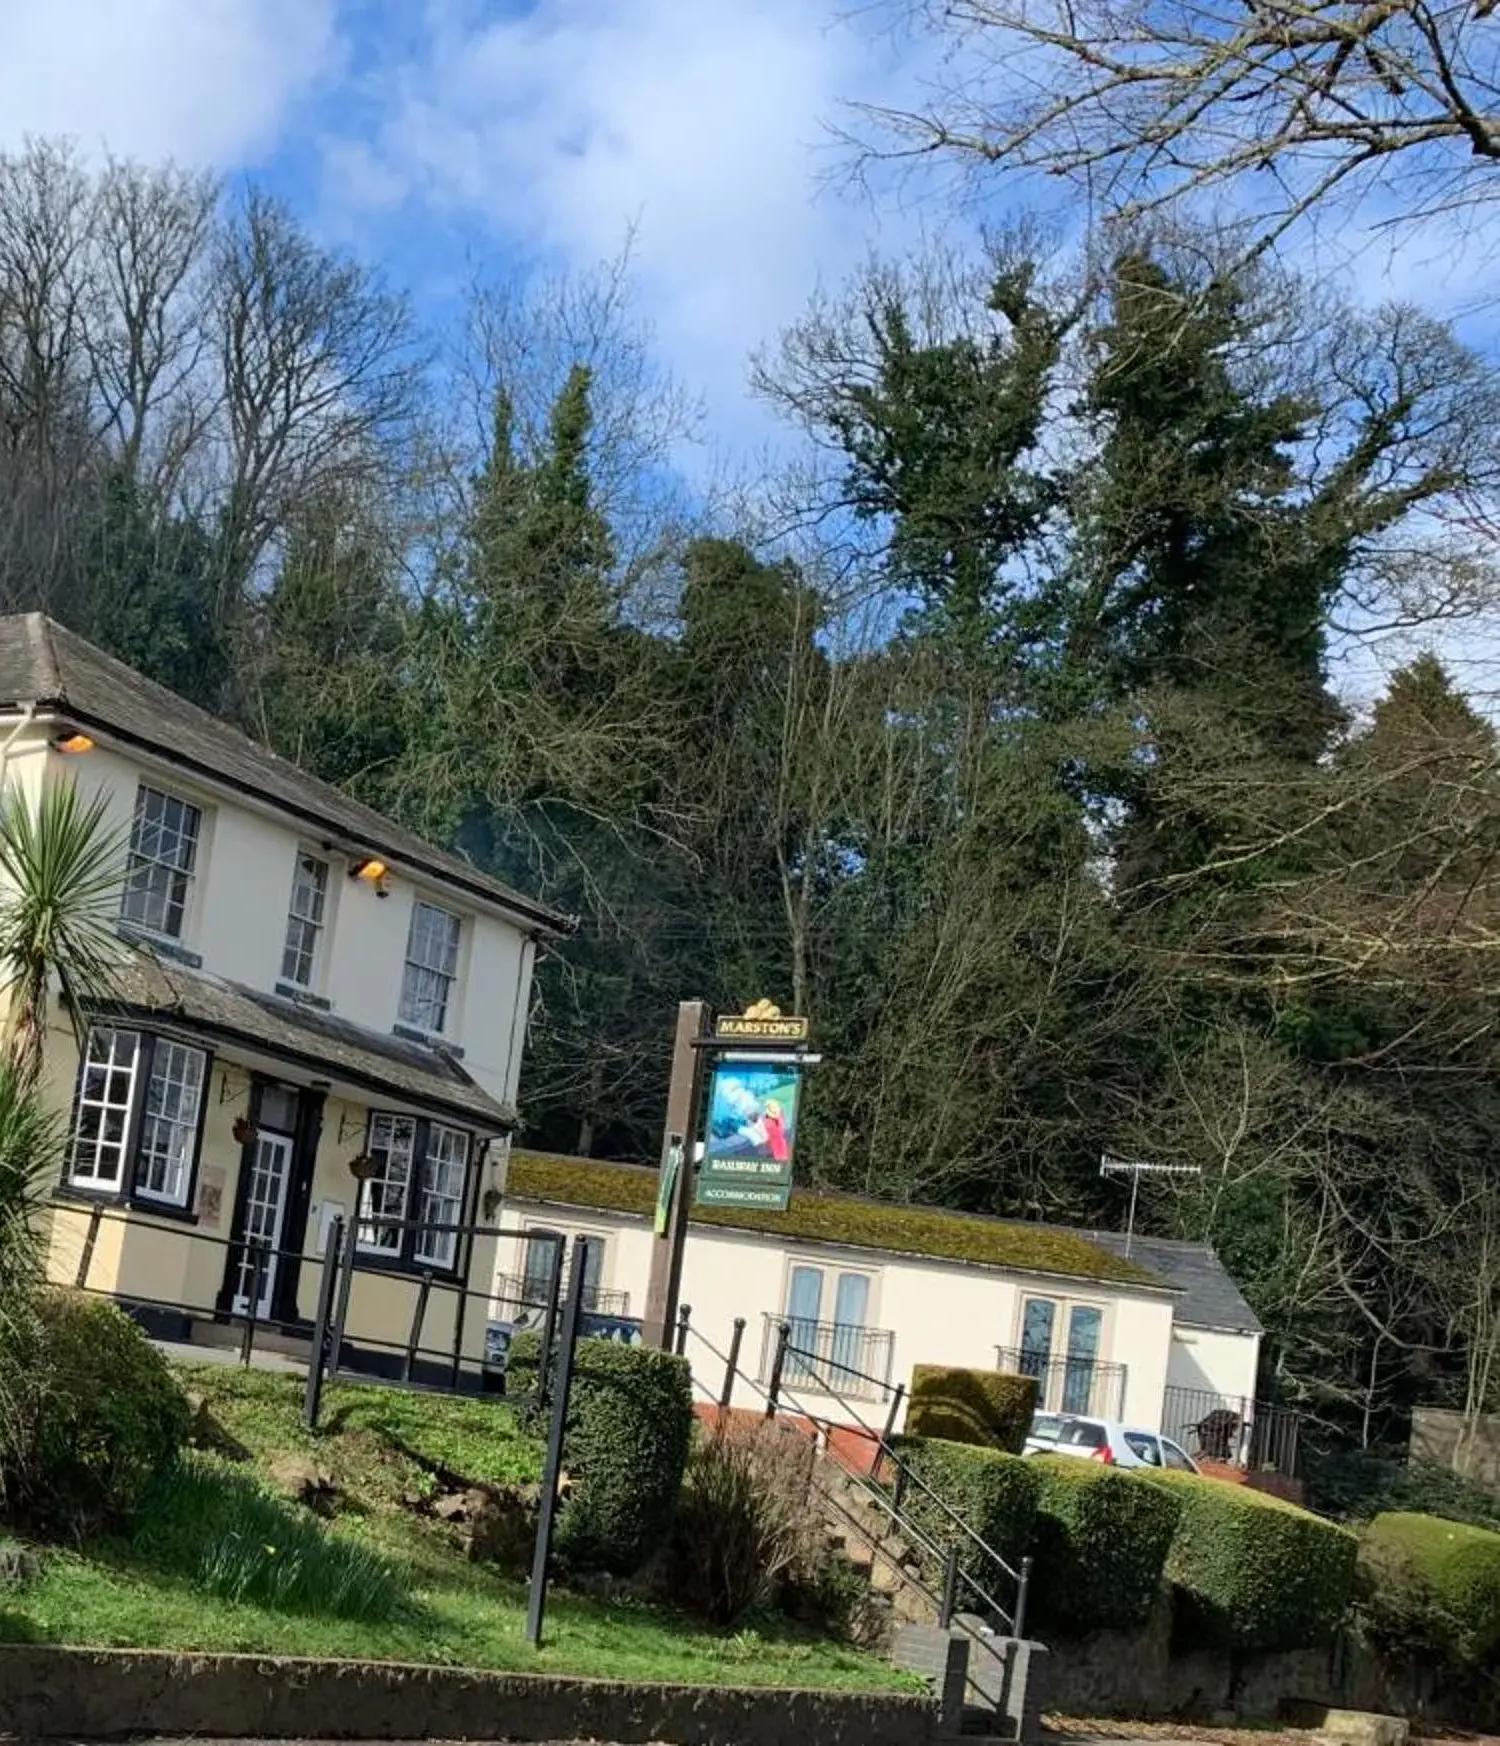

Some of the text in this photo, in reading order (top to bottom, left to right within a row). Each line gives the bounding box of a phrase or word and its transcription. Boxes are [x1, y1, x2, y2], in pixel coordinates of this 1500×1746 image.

[720, 1021, 802, 1035] MARSTON'S
[712, 1159, 781, 1173] RAILWAY INN
[705, 1189, 781, 1202] ACCOMMODATION
